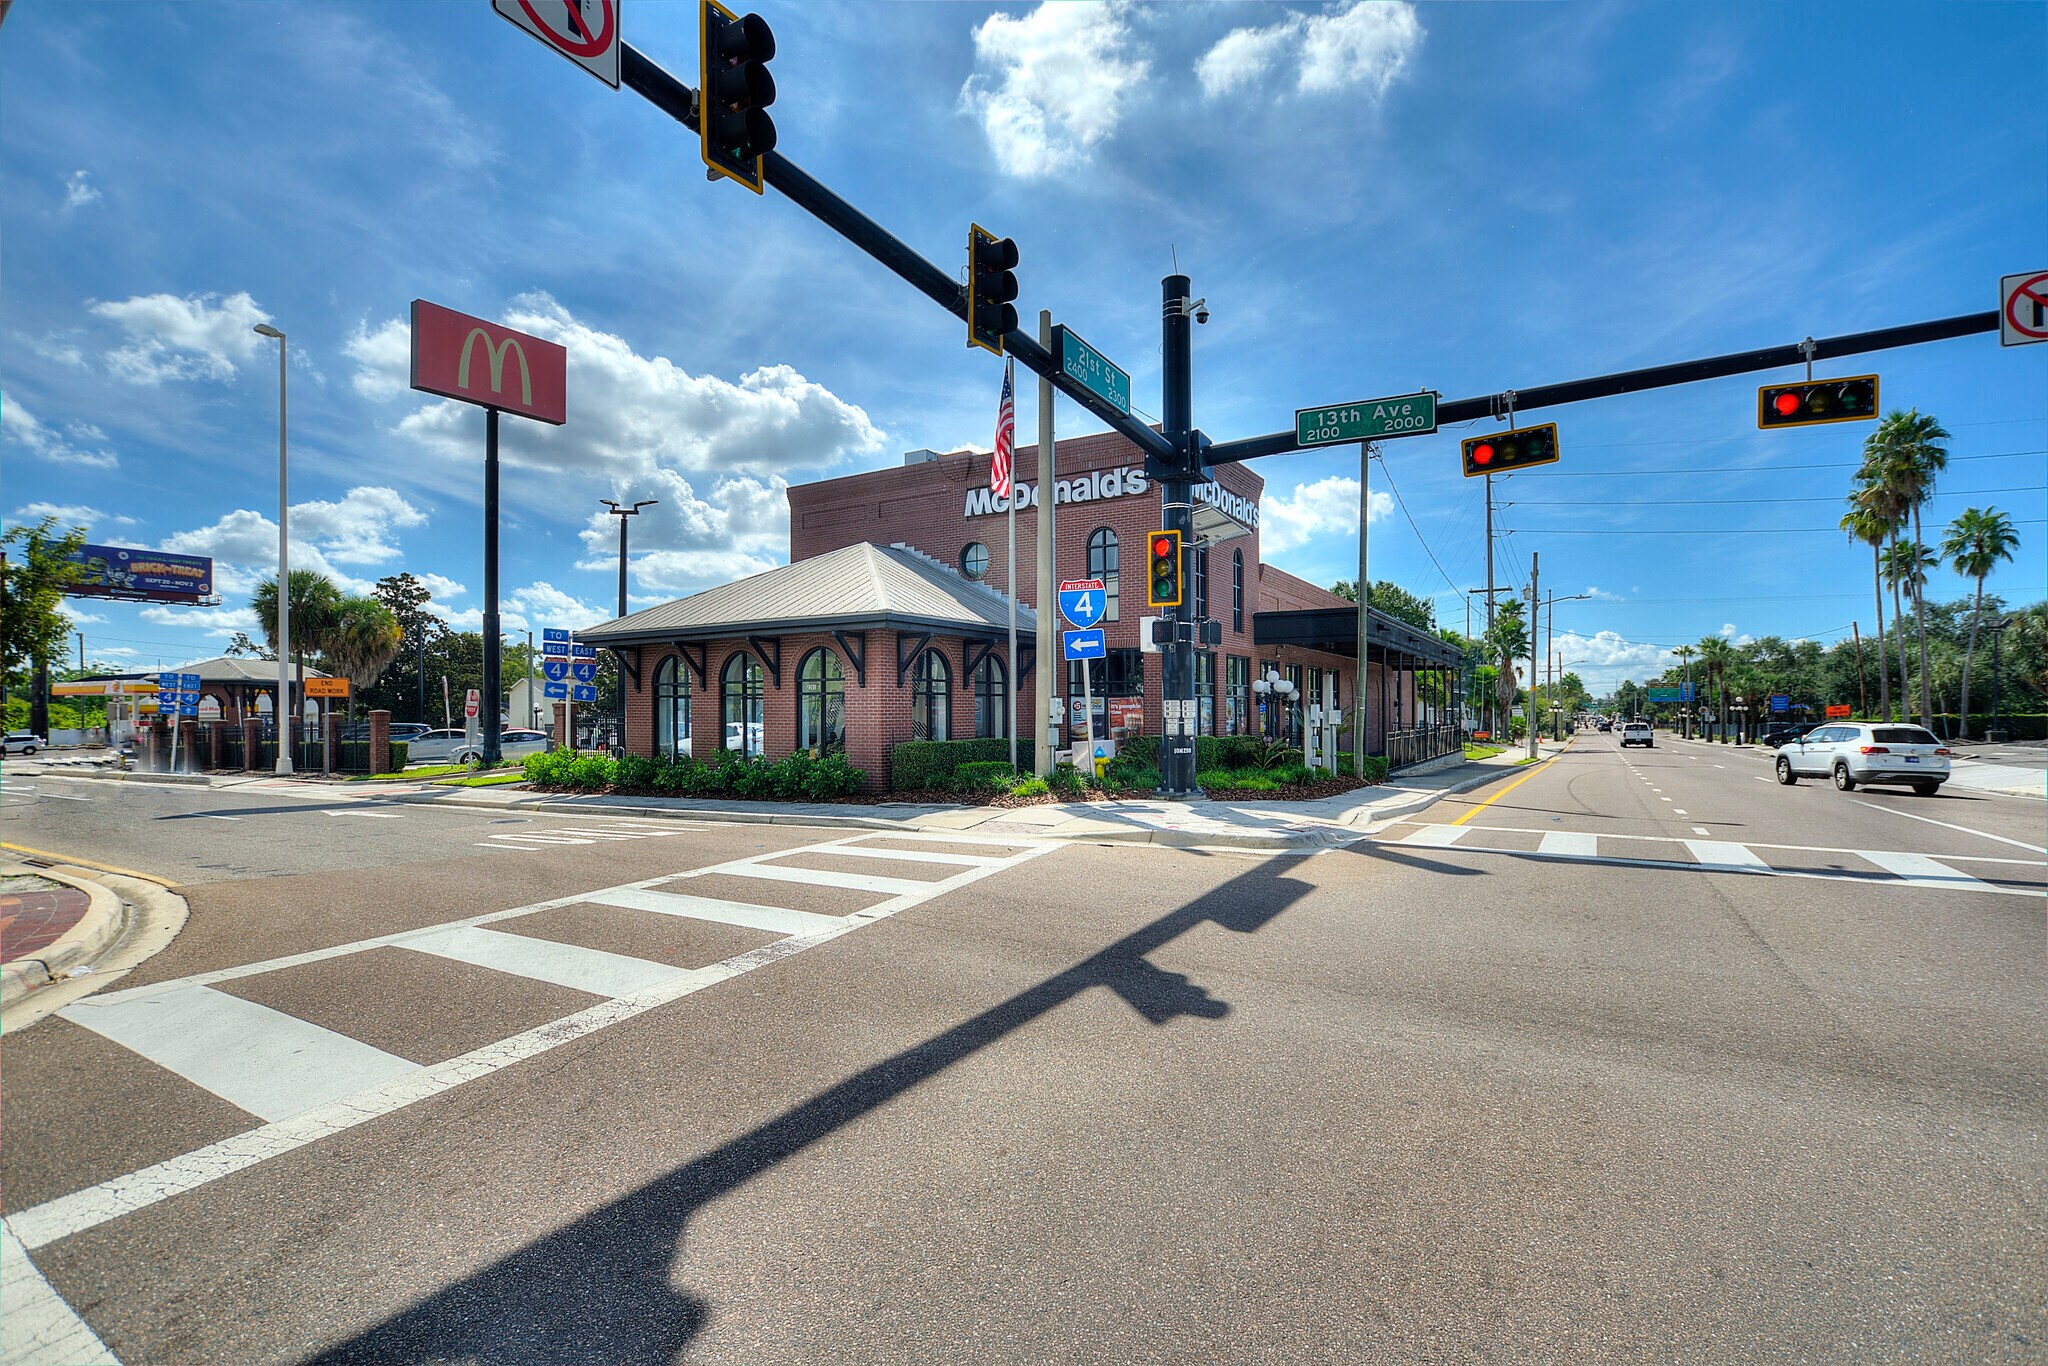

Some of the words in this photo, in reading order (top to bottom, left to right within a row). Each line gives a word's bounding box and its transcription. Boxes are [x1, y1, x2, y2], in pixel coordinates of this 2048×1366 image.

[1079, 346, 1100, 376] 21st
[1105, 366, 1116, 387] St
[1066, 357, 1088, 381] 2400
[1108, 387, 1126, 408] 2300
[1317, 408, 1361, 427] 13th
[1372, 404, 1412, 420] Ave
[1306, 426, 1340, 441] 2100
[1384, 415, 1425, 431] 2000
[1065, 582, 1100, 590] INTERSTATE
[1074, 591, 1093, 618] 4
[550, 631, 563, 640] TO
[546, 645, 566, 654] WEST
[575, 647, 593, 656] EAST
[550, 663, 561, 677] 4
[579, 664, 590, 678] 4
[163, 693, 172, 702] 4
[185, 694, 194, 702] 4
